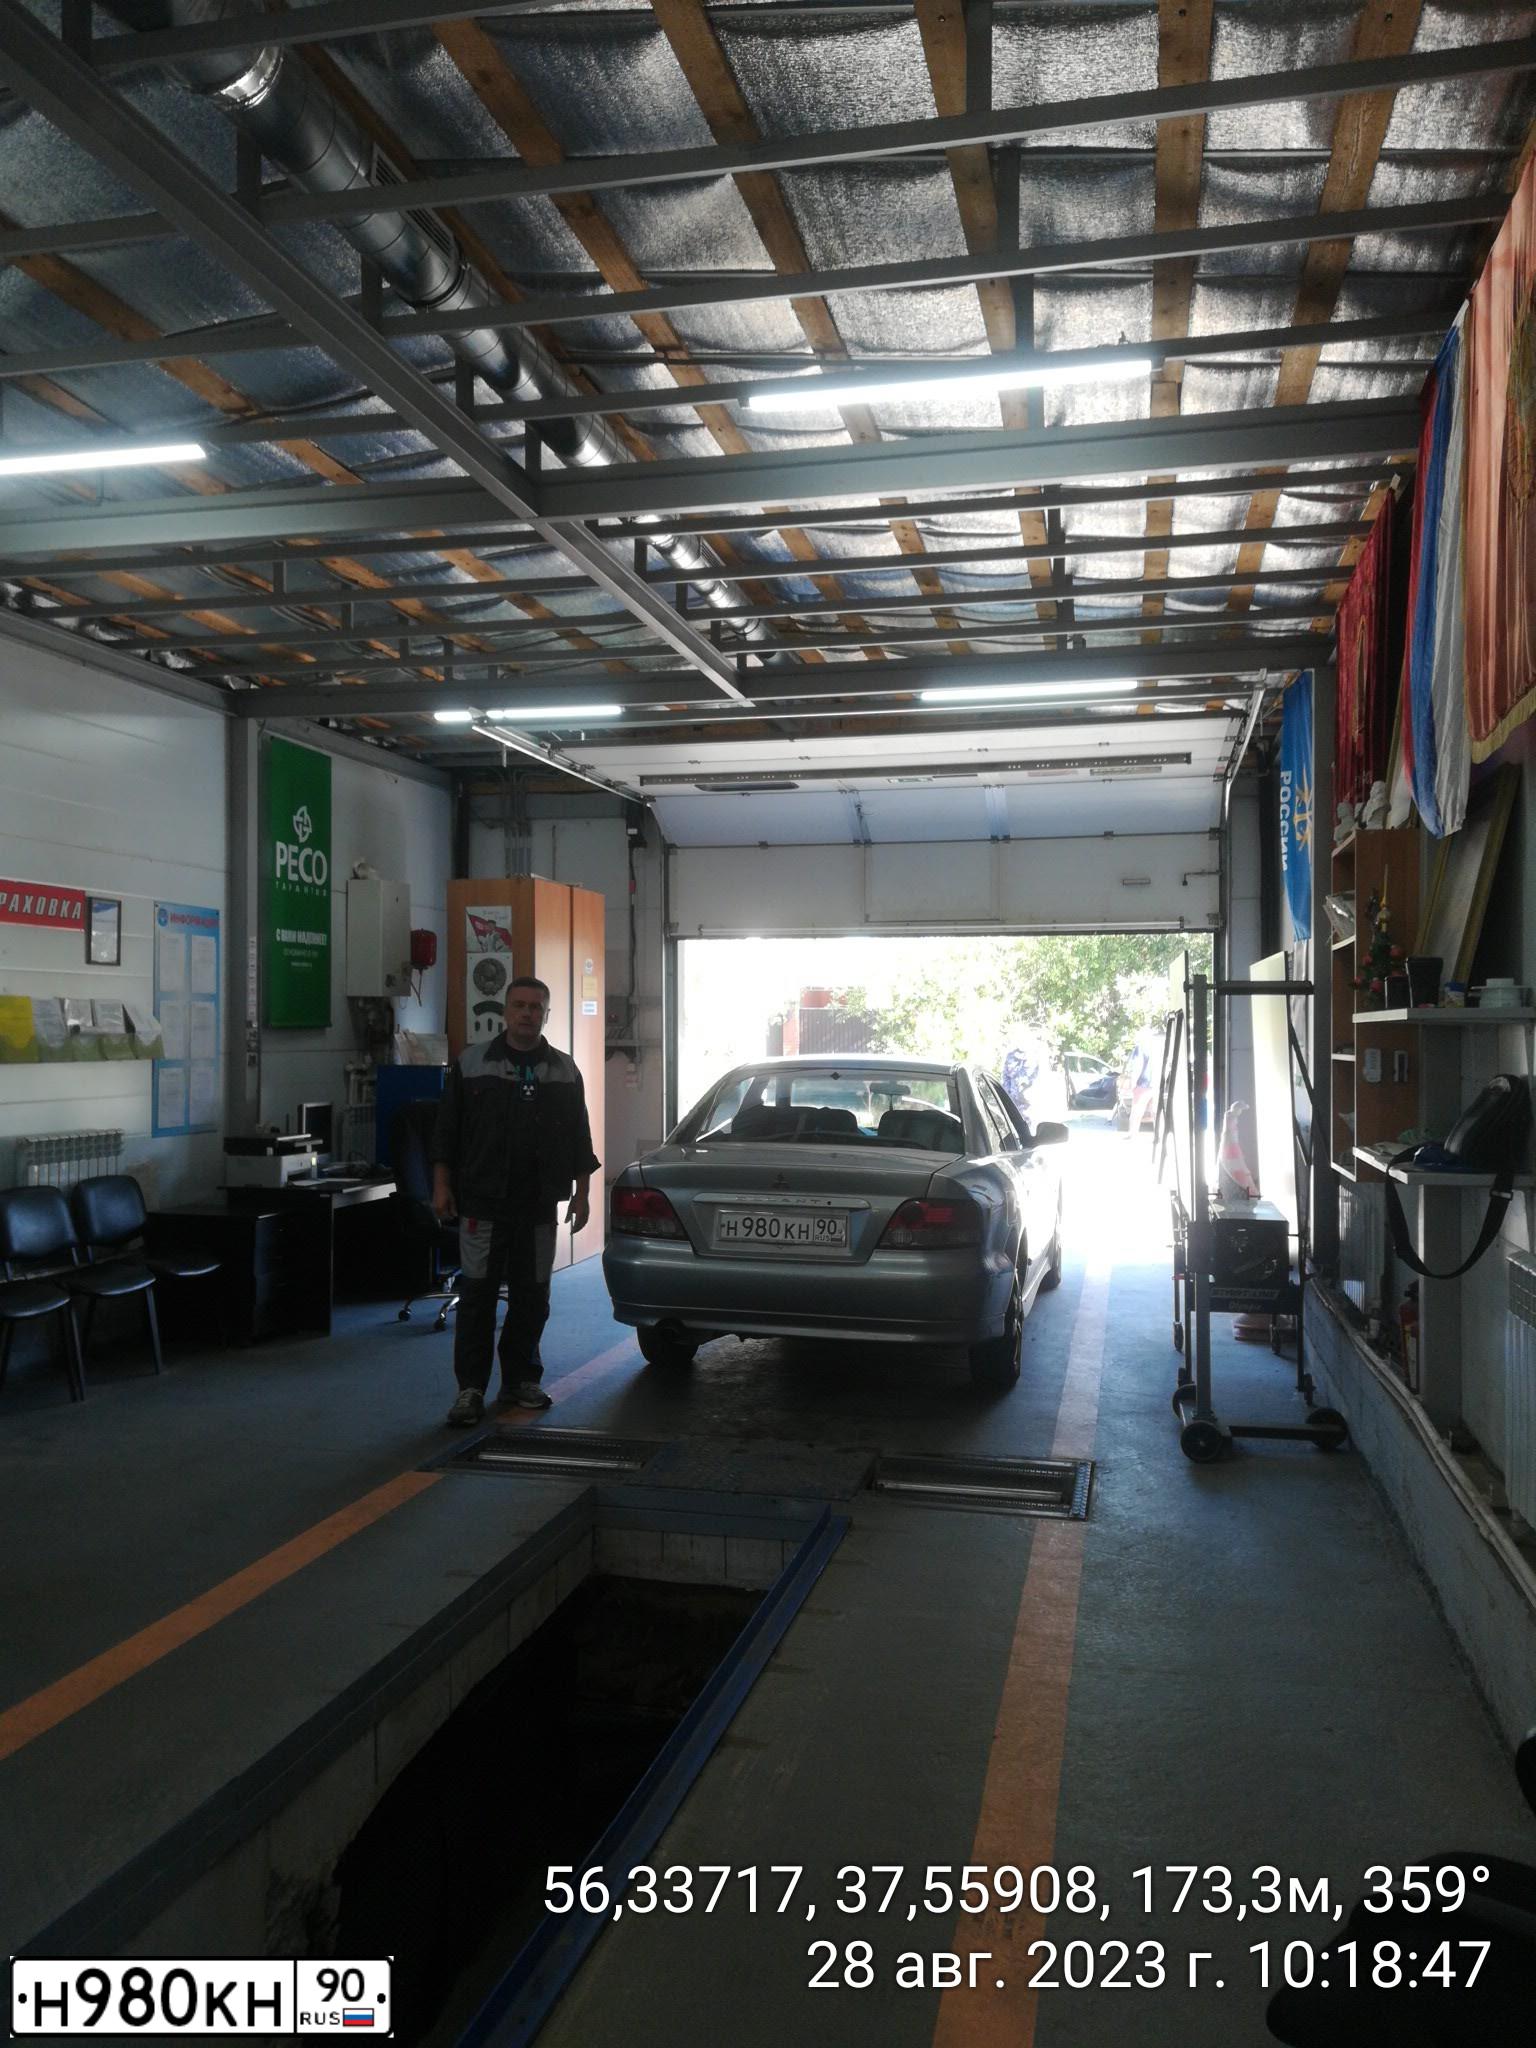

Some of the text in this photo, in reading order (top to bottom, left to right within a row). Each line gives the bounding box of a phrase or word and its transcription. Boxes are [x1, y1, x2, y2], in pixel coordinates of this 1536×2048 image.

[276, 840, 328, 886] РЕСО
[726, 1216, 837, 1240] Н980КН 90
